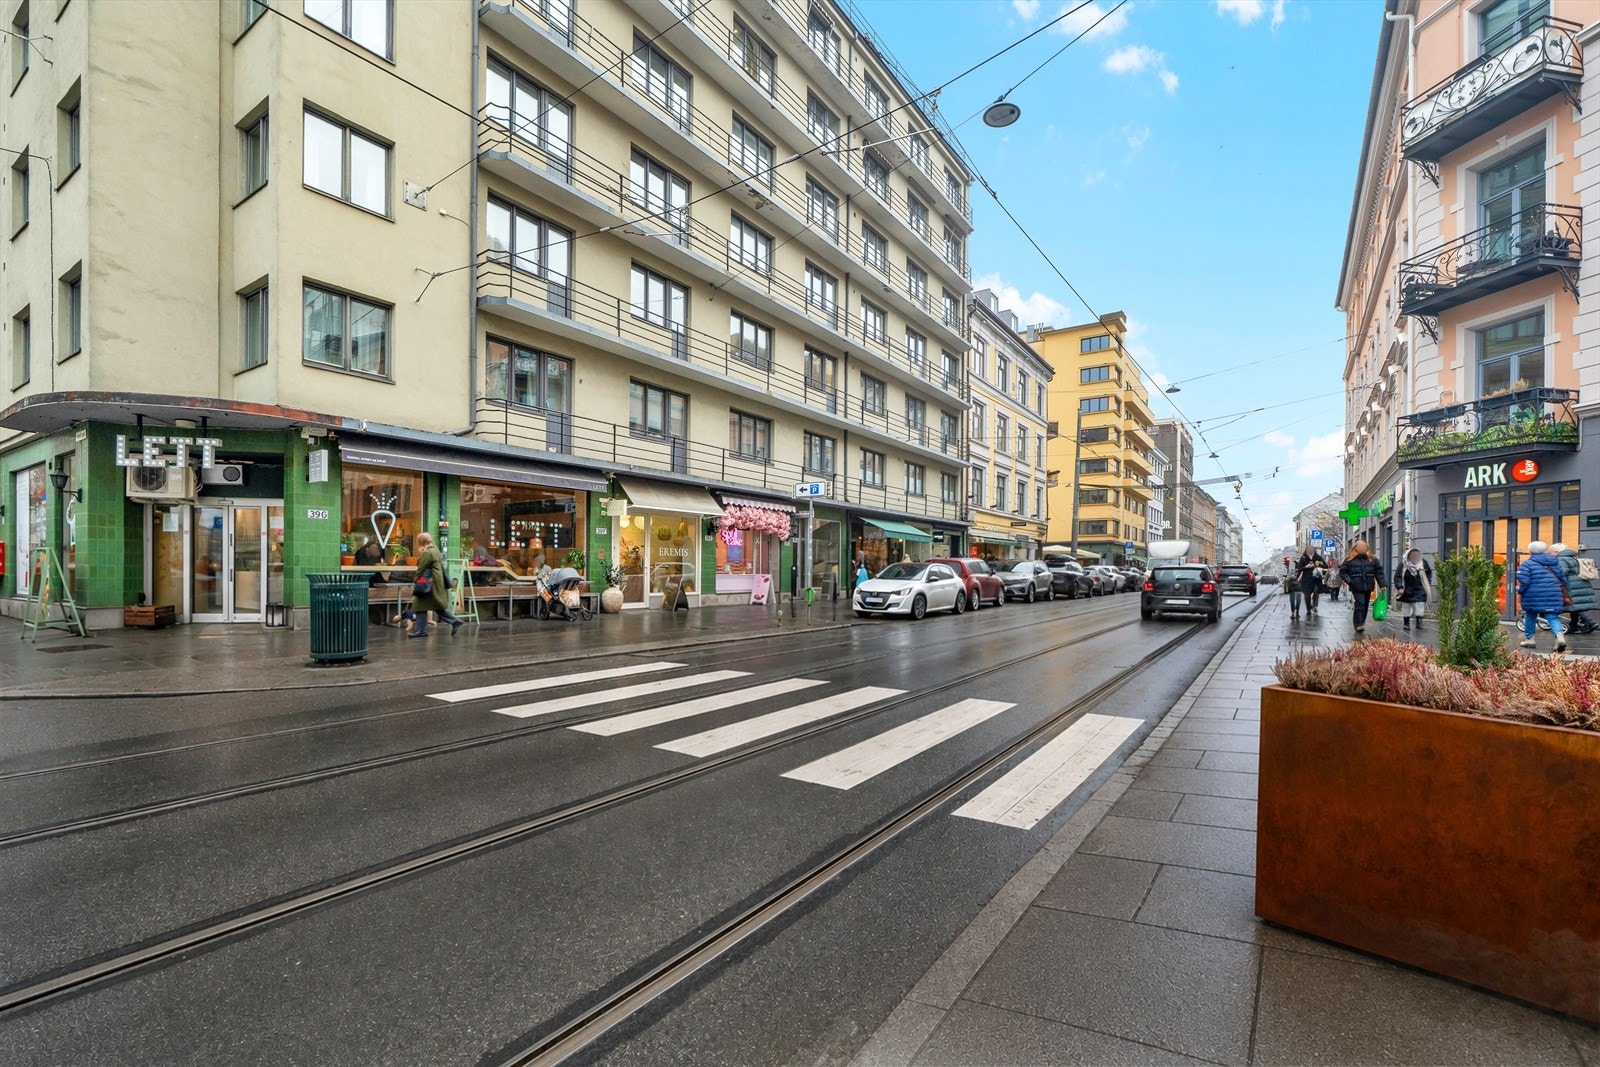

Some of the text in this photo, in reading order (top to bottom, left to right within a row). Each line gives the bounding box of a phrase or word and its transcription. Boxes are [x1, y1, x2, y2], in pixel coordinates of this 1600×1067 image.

[116, 434, 222, 469] LETT
[1464, 462, 1507, 488] ARK
[309, 510, 328, 518] 39G
[490, 518, 563, 549] LETT
[659, 547, 689, 557] EREMIS
